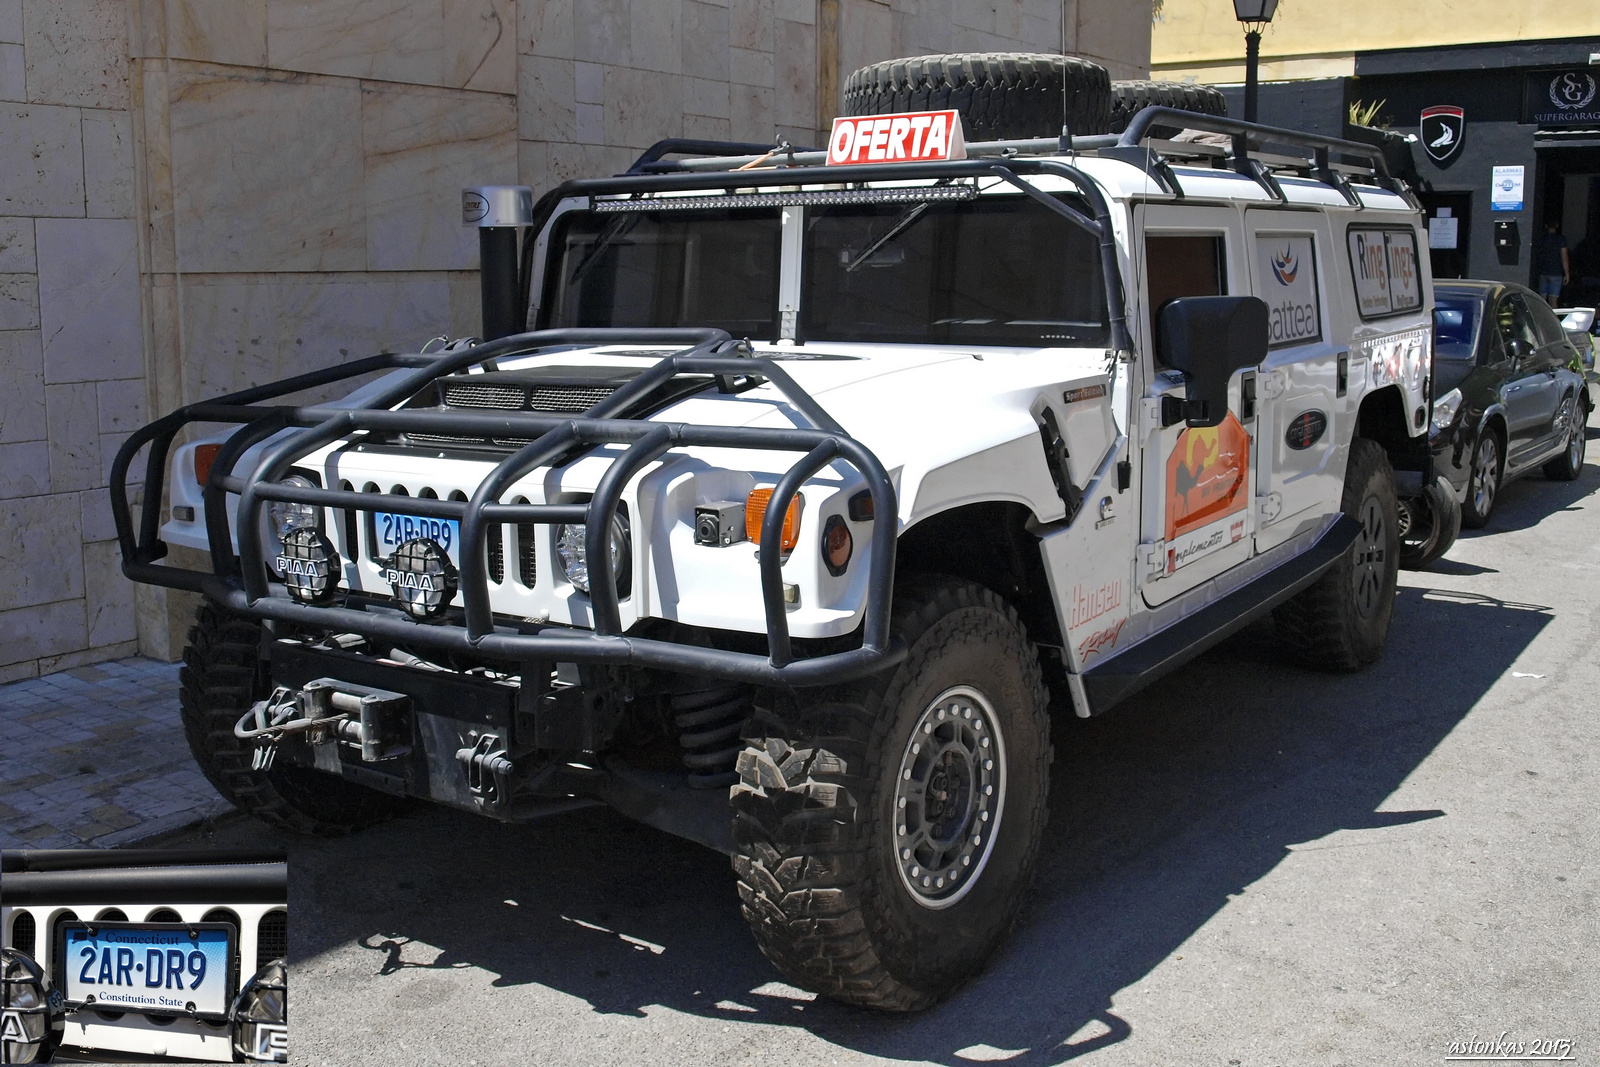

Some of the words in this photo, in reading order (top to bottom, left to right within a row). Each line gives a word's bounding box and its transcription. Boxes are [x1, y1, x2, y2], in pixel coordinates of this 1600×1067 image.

[831, 114, 947, 163] OFERTA
[1066, 391, 1084, 402] Sport
[276, 556, 319, 577] PIAA
[386, 568, 434, 591] PIAA
[105, 932, 180, 946] Connecticut
[99, 991, 155, 1005] Constitution
[158, 995, 183, 1007] State
